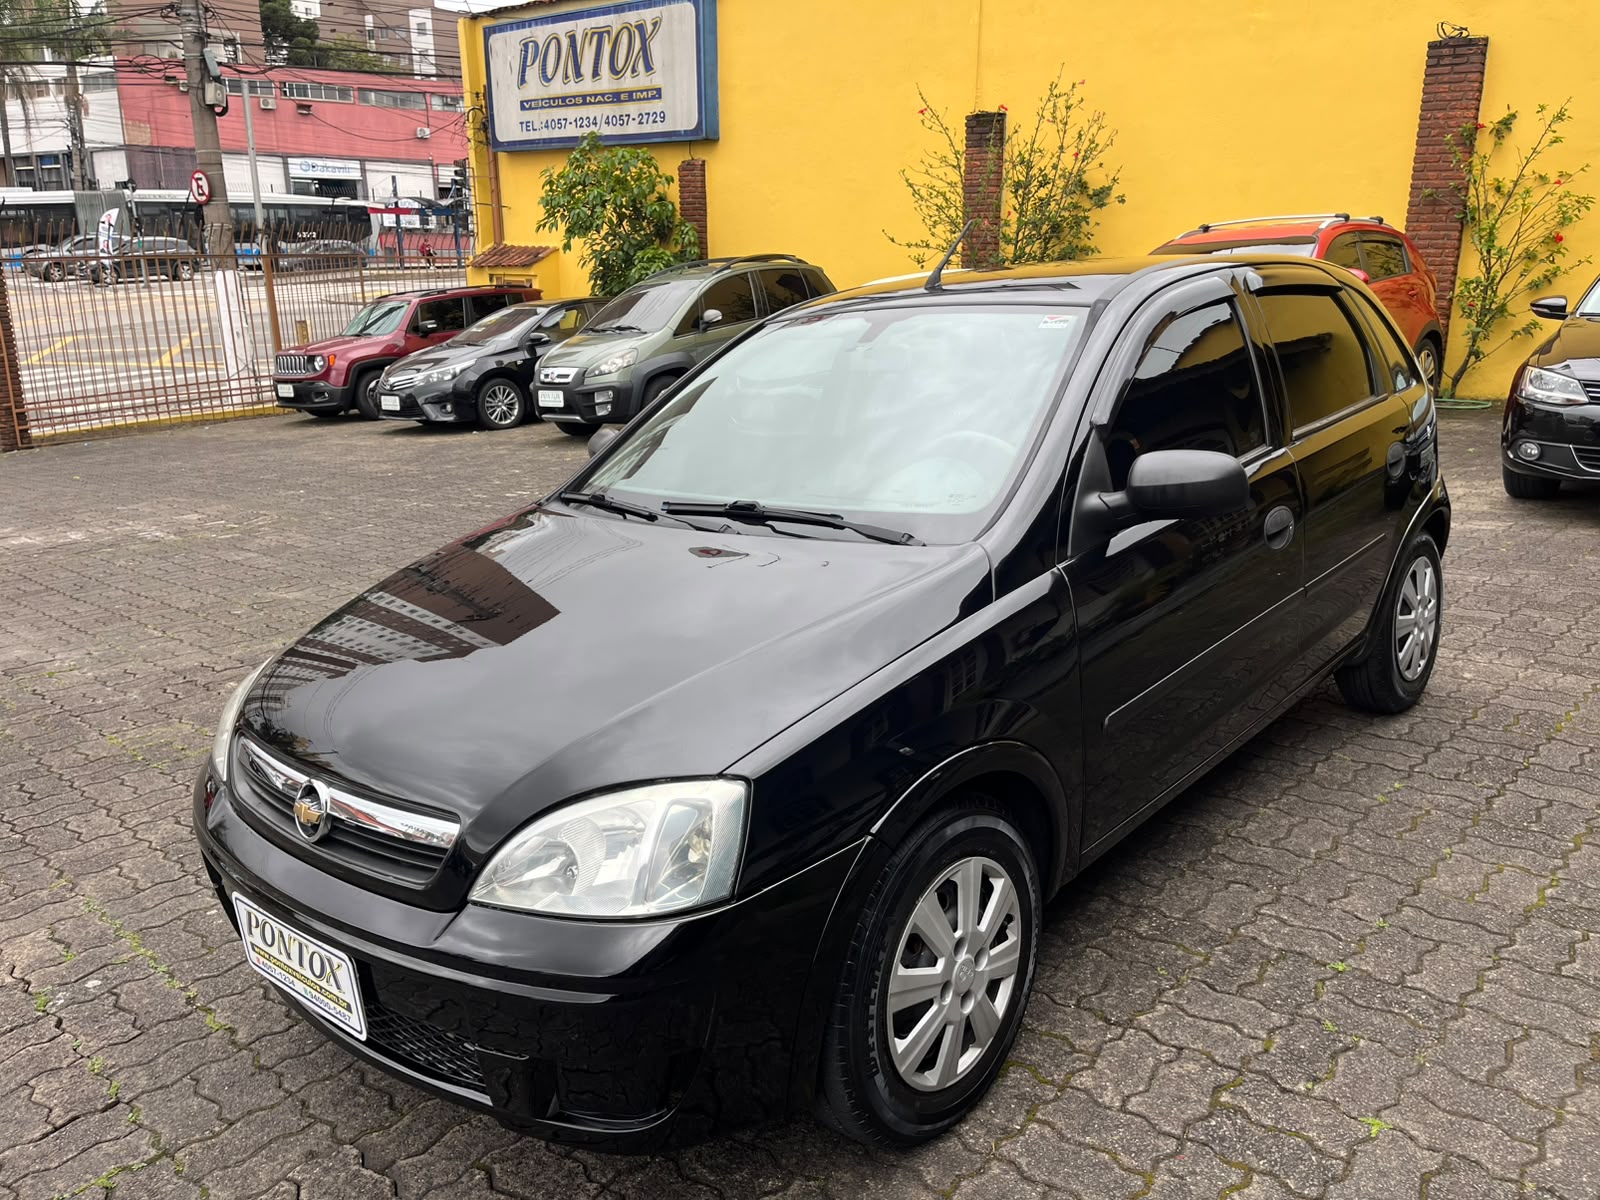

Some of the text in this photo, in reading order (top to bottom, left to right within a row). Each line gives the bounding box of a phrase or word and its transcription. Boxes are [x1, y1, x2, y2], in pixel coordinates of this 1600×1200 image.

[517, 16, 663, 90] PONTOX
[586, 94, 617, 104] NAC.
[620, 93, 629, 101] E
[633, 90, 660, 99] IMP.
[244, 908, 346, 995] PONTOX
